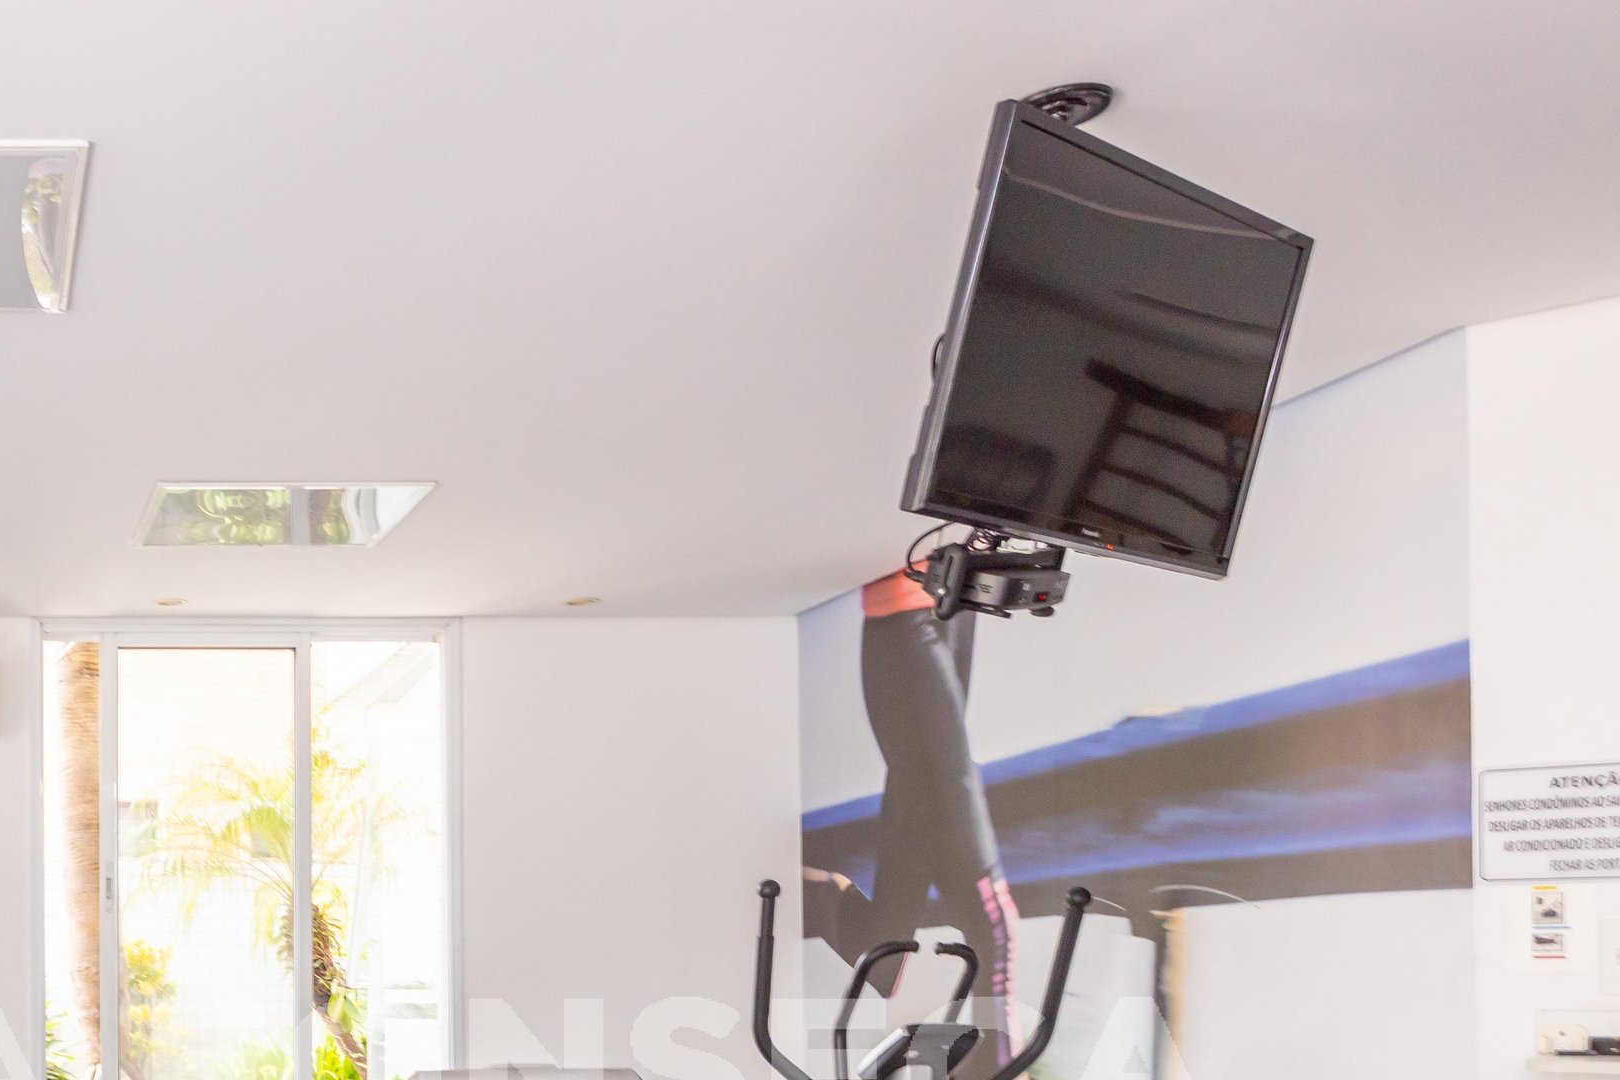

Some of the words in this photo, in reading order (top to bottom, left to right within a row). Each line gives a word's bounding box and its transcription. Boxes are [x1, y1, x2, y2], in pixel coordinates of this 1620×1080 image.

[1549, 771, 1620, 788] ATENÇÃ
[1484, 799, 1528, 812] SENHORES
[1488, 820, 1527, 831] DESLIGAR
[1530, 819, 1541, 830] OS
[1543, 817, 1592, 830] APARELHOS
[1515, 838, 1583, 852] CONDICIONADO
